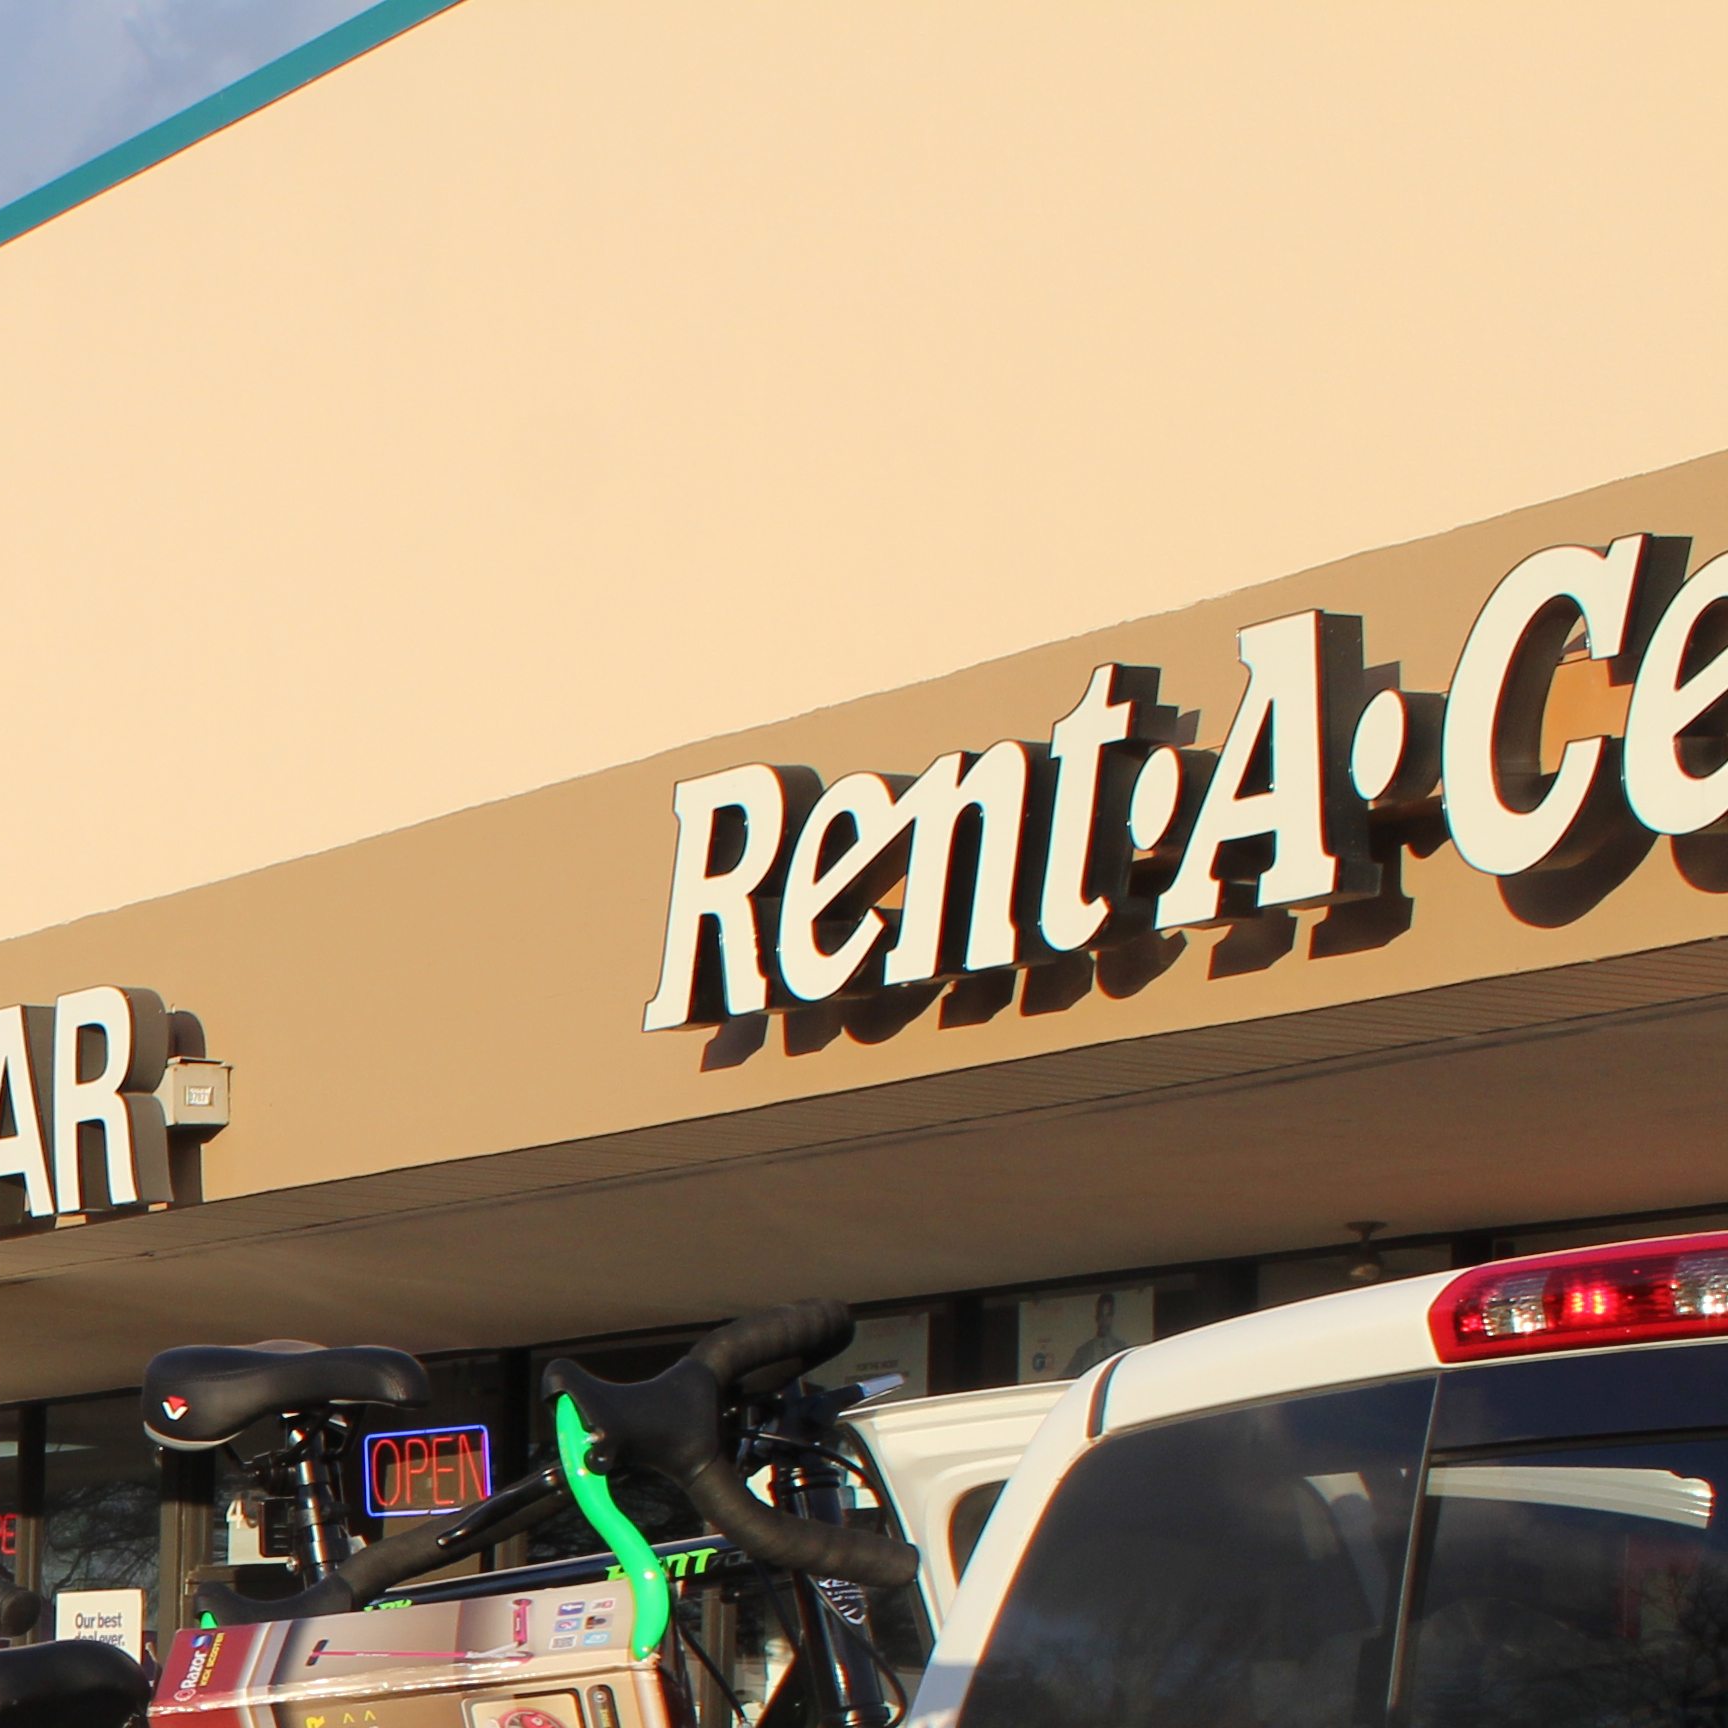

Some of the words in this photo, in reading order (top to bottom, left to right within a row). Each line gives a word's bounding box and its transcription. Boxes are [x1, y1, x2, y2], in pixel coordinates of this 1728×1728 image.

[371, 1432, 488, 1507] OPEN
[75, 1612, 96, 1629] Our
[97, 1611, 123, 1629] best
